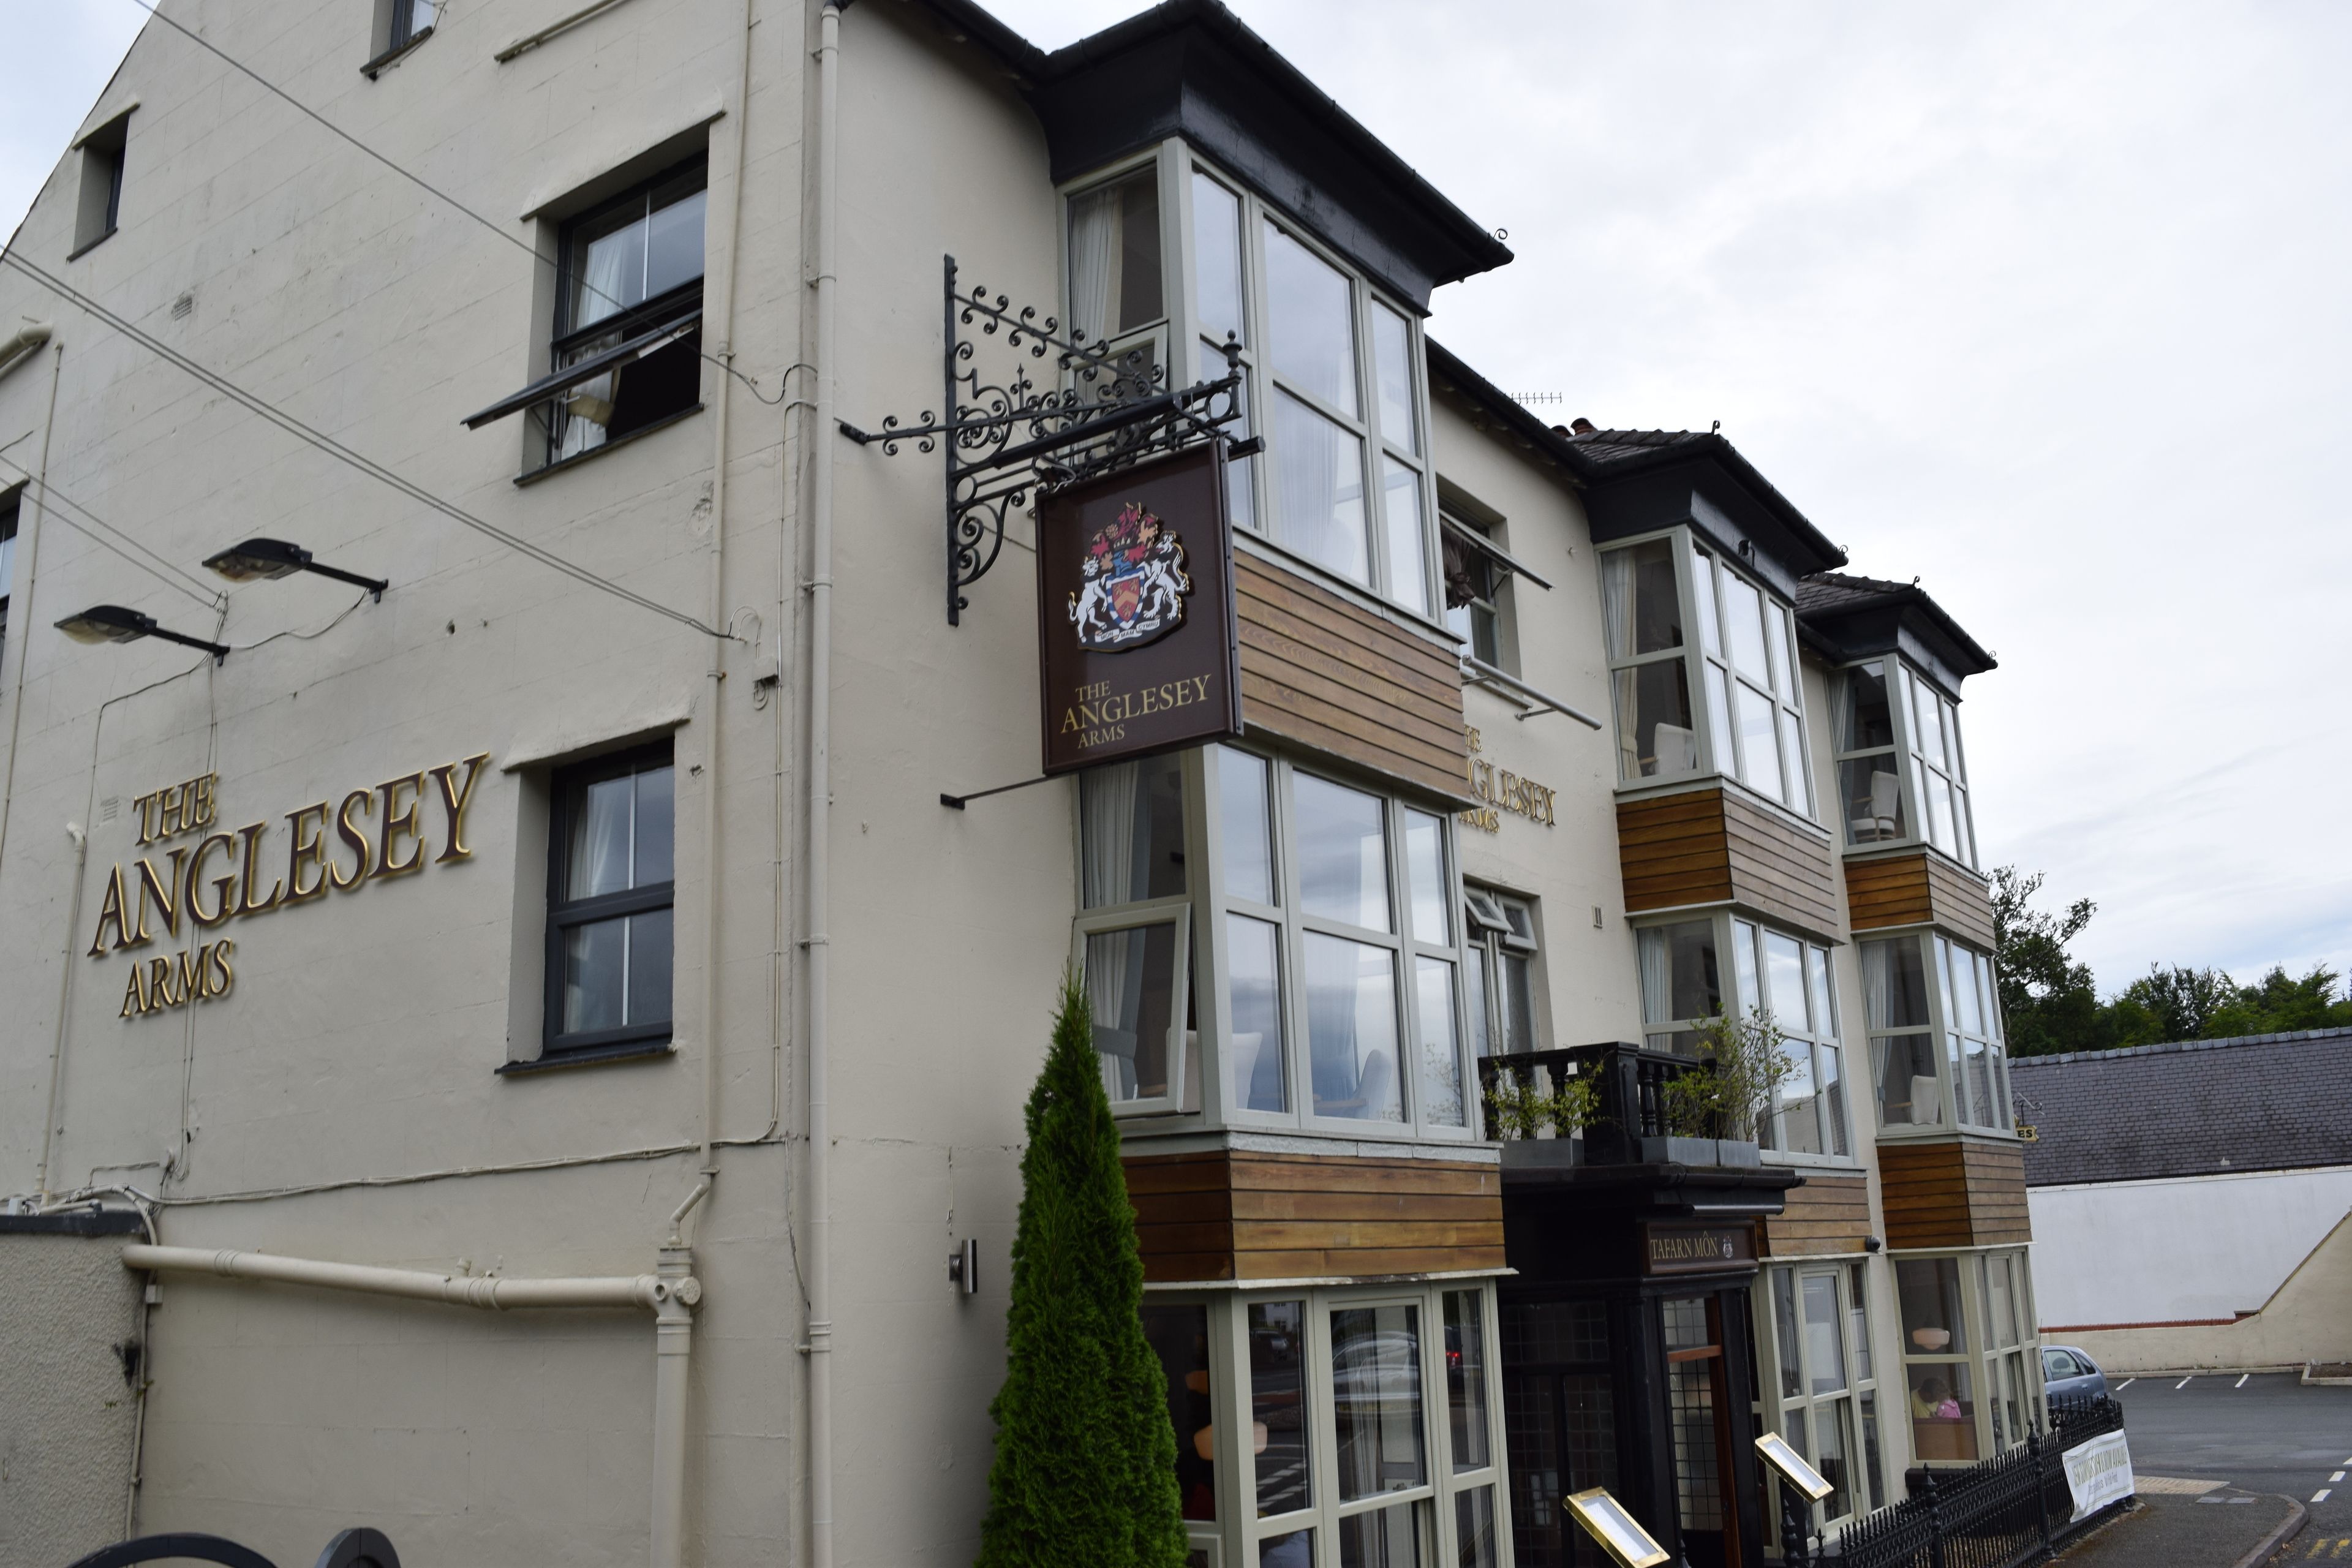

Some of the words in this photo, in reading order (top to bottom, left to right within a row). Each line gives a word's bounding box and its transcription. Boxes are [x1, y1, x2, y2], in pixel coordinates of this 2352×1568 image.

[1060, 674, 1212, 734] ANGLESEY
[1075, 680, 1111, 703] THE
[1078, 723, 1125, 749] ARMS
[133, 771, 219, 846] THE
[87, 751, 489, 957] ANGLESEY
[119, 937, 236, 1019] ARMS
[1650, 1238, 1692, 1259] TAFARN
[1694, 1230, 1718, 1257] MÔN
